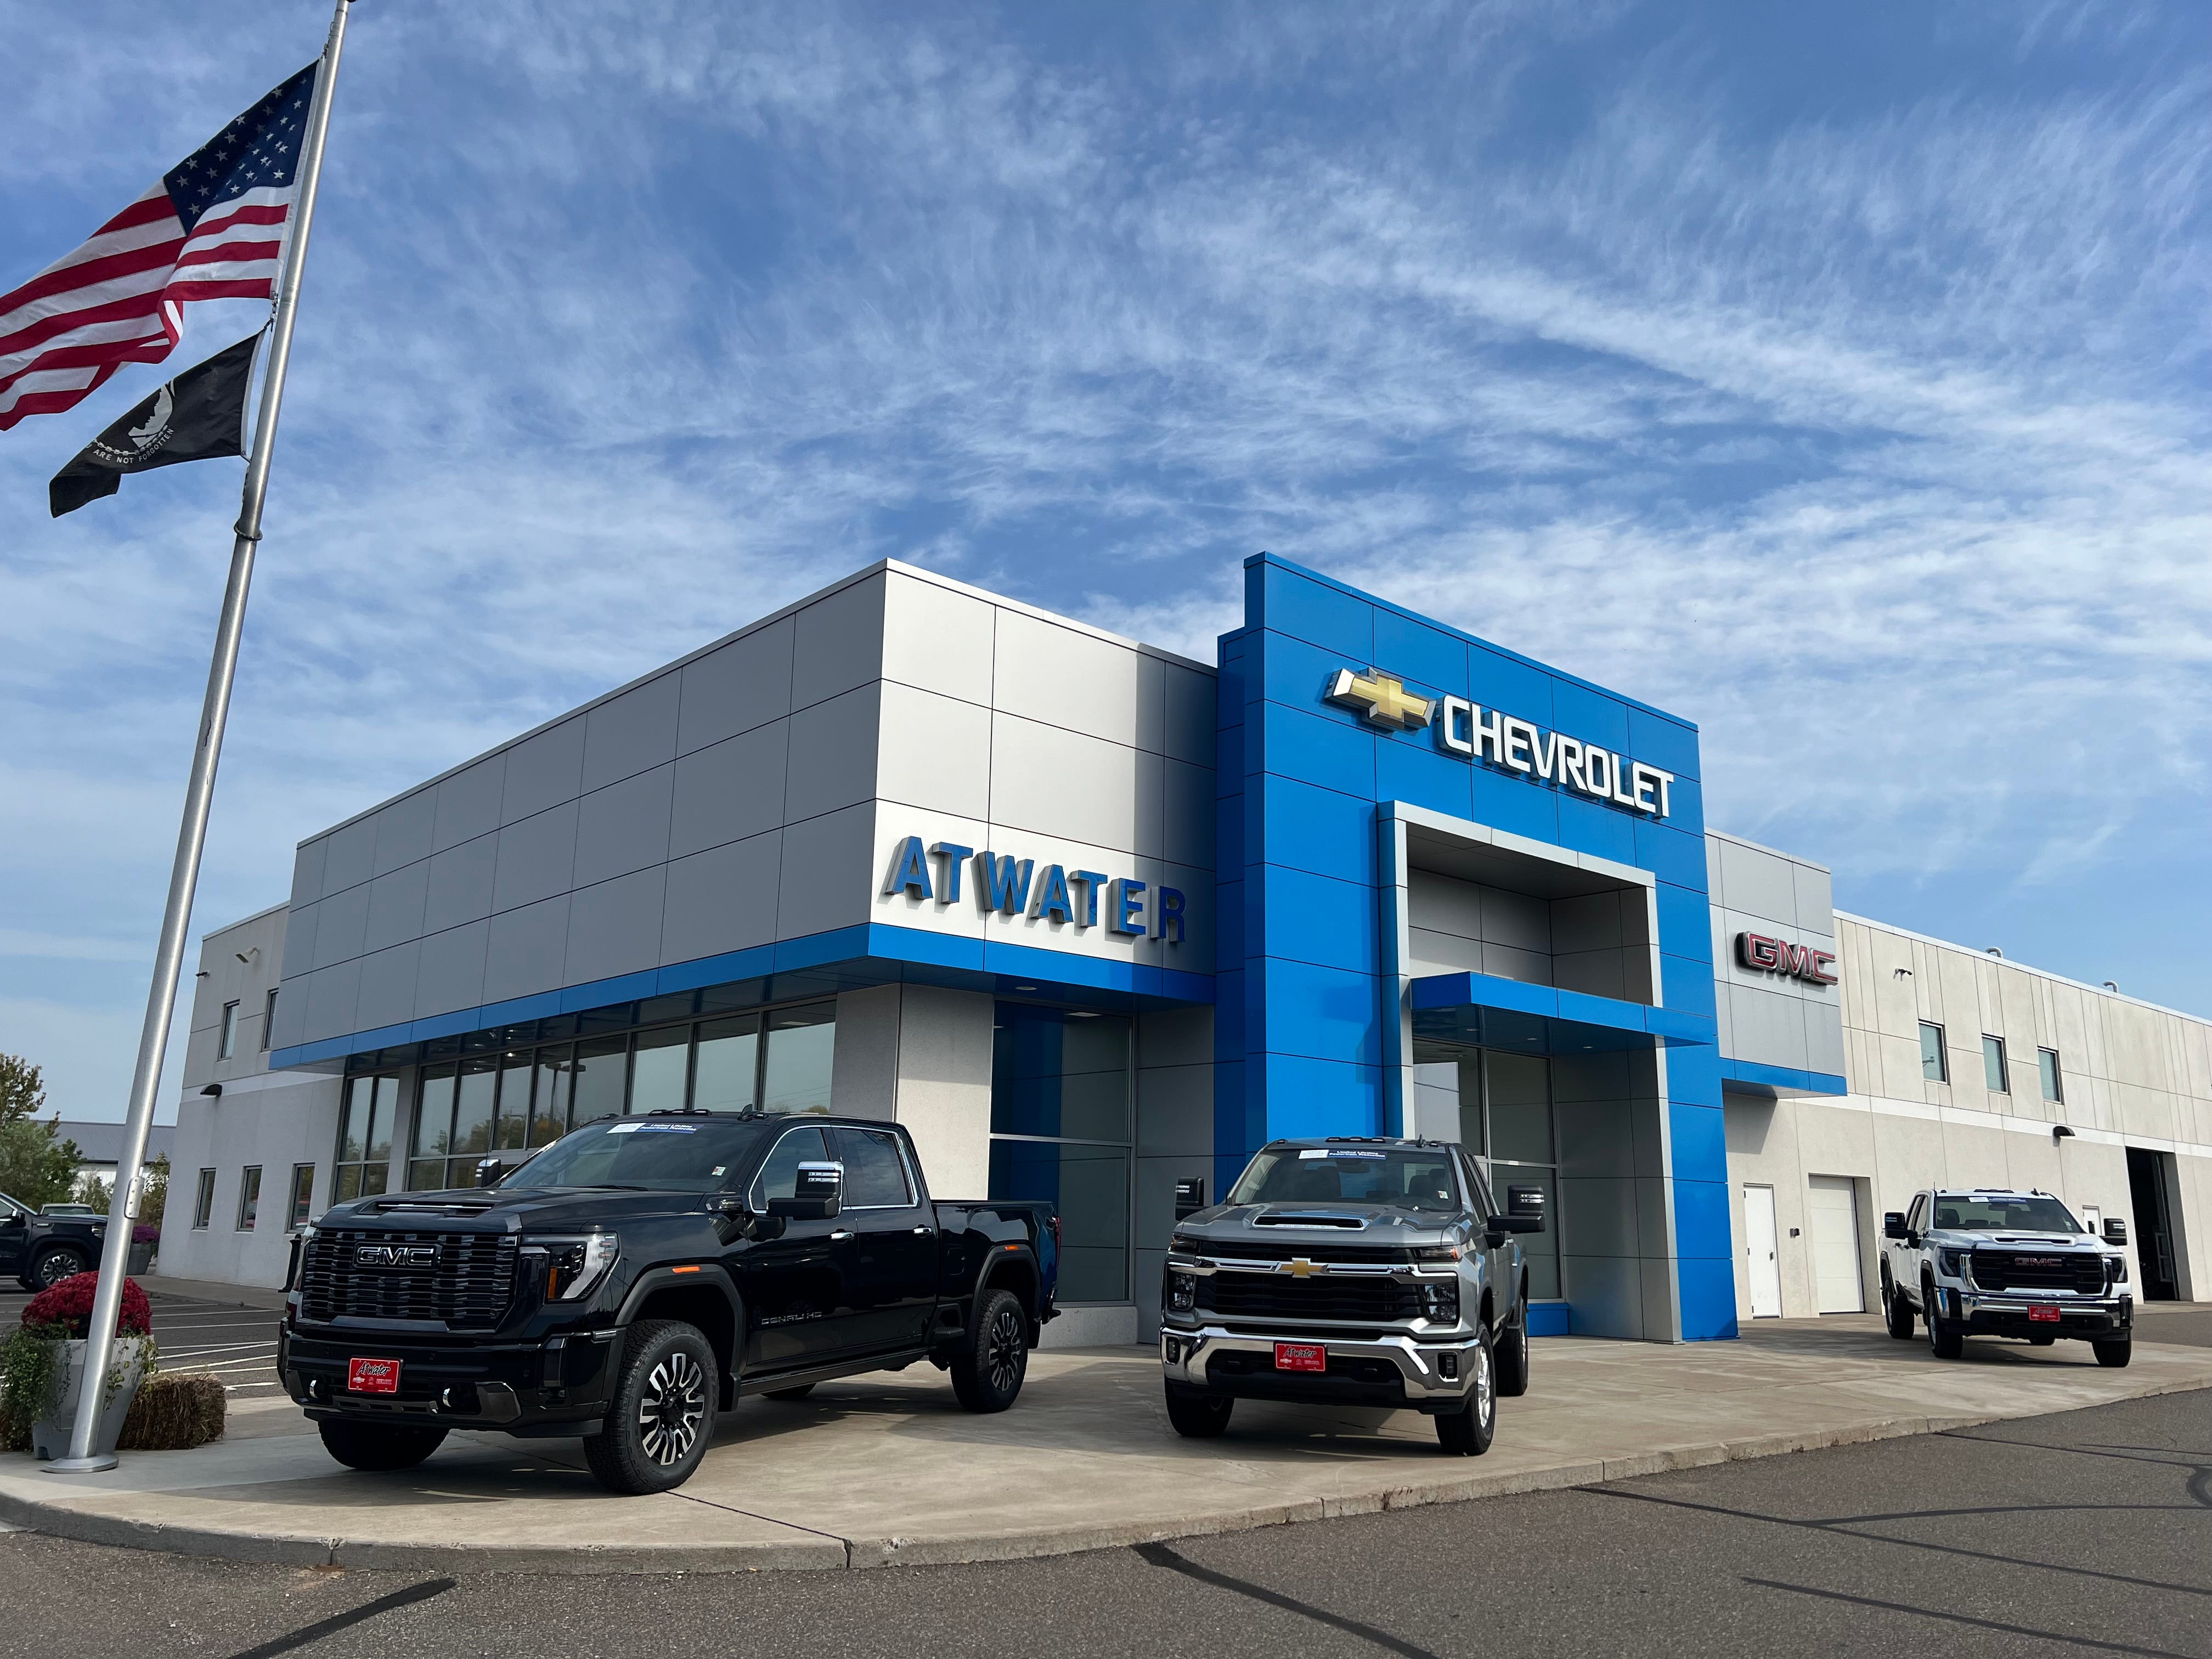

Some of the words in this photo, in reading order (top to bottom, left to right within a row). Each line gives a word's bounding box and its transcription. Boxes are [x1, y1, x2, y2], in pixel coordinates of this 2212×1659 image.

[93, 449, 112, 461] ARE
[138, 428, 174, 462] FORGOTTEN
[1437, 695, 1674, 818] CHEVROLET
[885, 836, 1186, 943] ATWATER
[1738, 932, 1838, 985] GMC
[357, 1246, 434, 1266] GMC
[2015, 1257, 2062, 1267] GMC
[761, 1314, 804, 1325] DENALI
[1283, 1346, 1317, 1359] Atwater
[356, 1361, 391, 1376] Atwater
